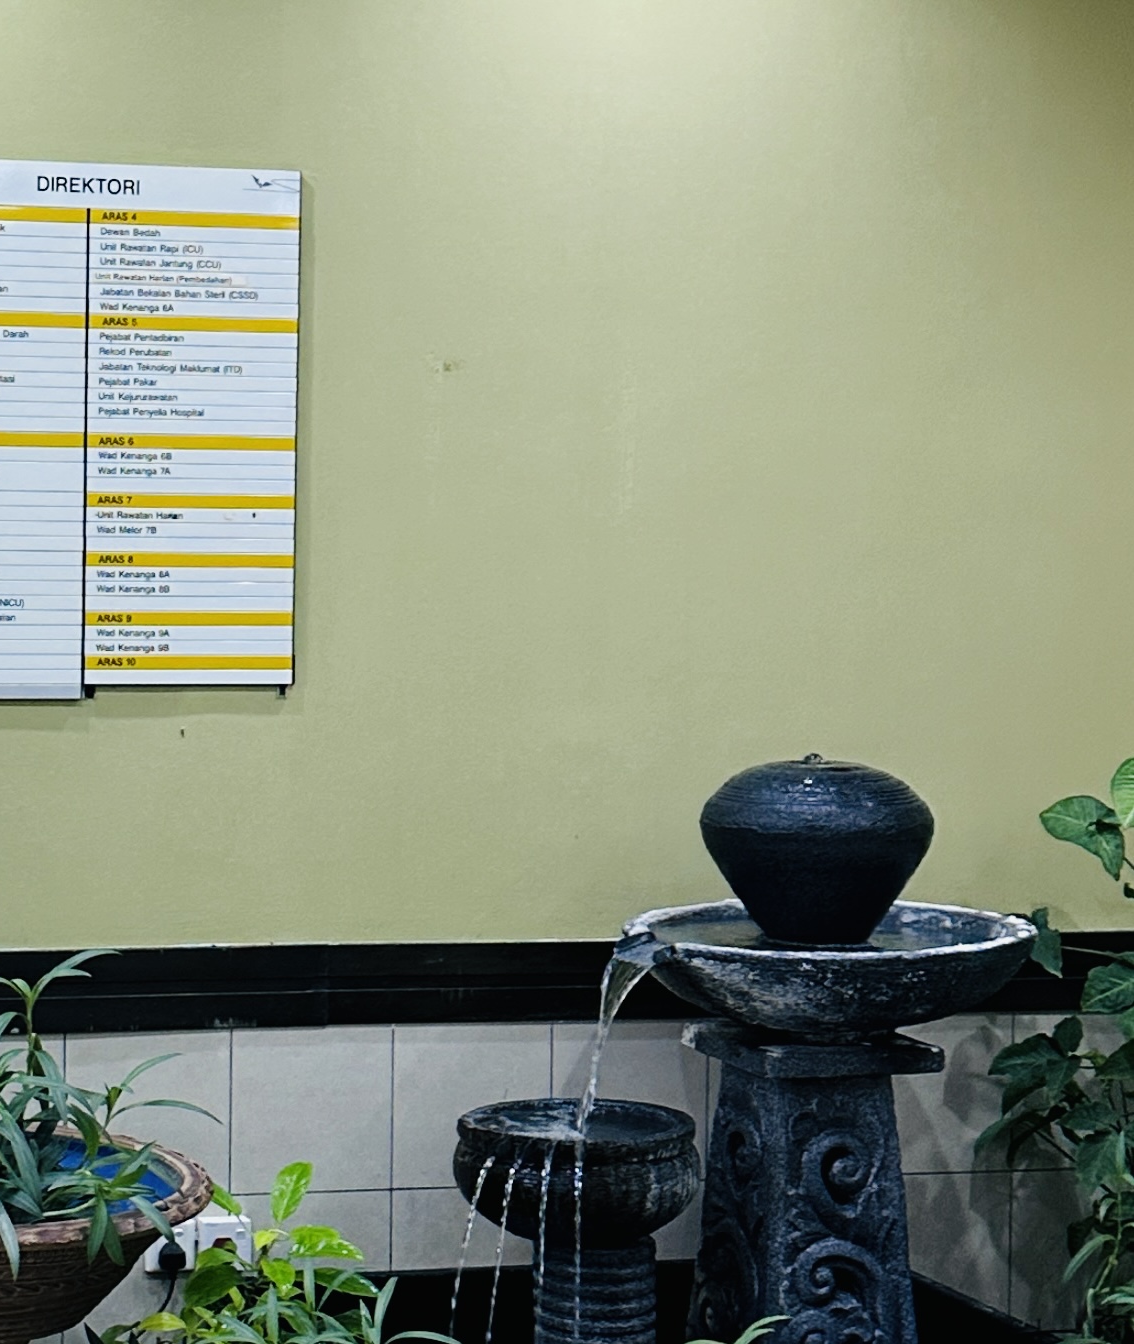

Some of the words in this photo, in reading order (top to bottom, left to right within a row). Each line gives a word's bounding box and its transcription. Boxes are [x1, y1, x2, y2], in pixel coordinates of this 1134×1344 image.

[36, 175, 141, 196] DIREKTORI
[101, 212, 128, 221] ARAS
[102, 317, 129, 326] ARAS
[98, 437, 125, 445] ARAS
[97, 496, 124, 504] ARAS
[98, 555, 125, 564] ARAS
[97, 614, 123, 623] ARAS
[97, 658, 123, 666] ARAS
[126, 658, 136, 666] 10
